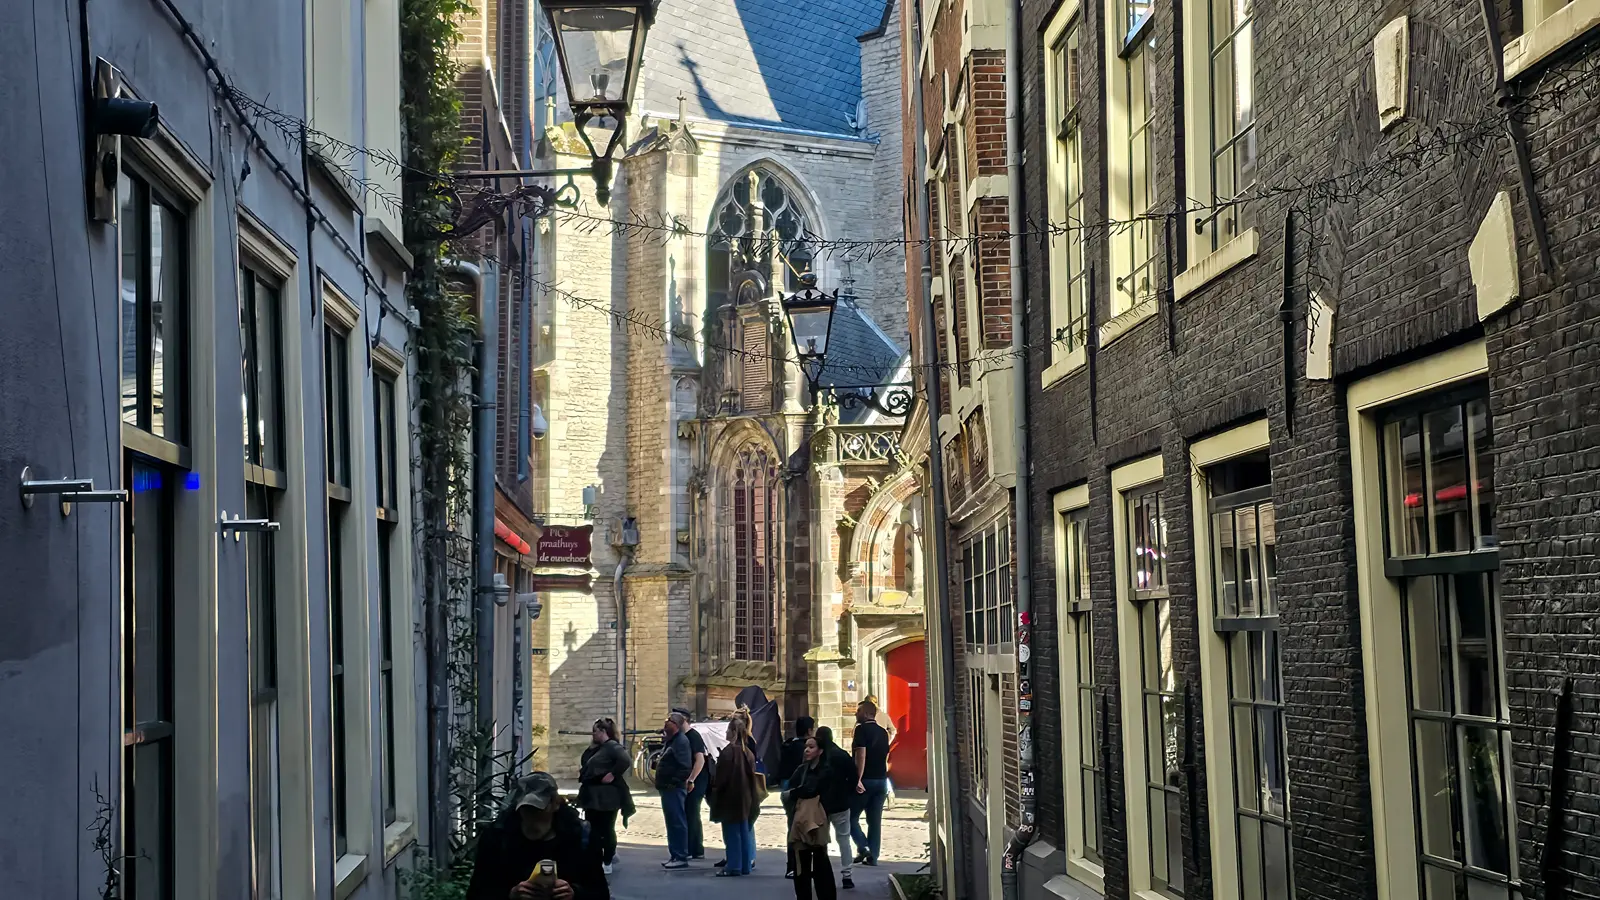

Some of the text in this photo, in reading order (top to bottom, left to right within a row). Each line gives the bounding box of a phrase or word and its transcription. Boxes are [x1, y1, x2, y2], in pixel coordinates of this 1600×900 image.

[540, 538, 578, 551] praathuys
[539, 552, 587, 563] de ouwehoer
